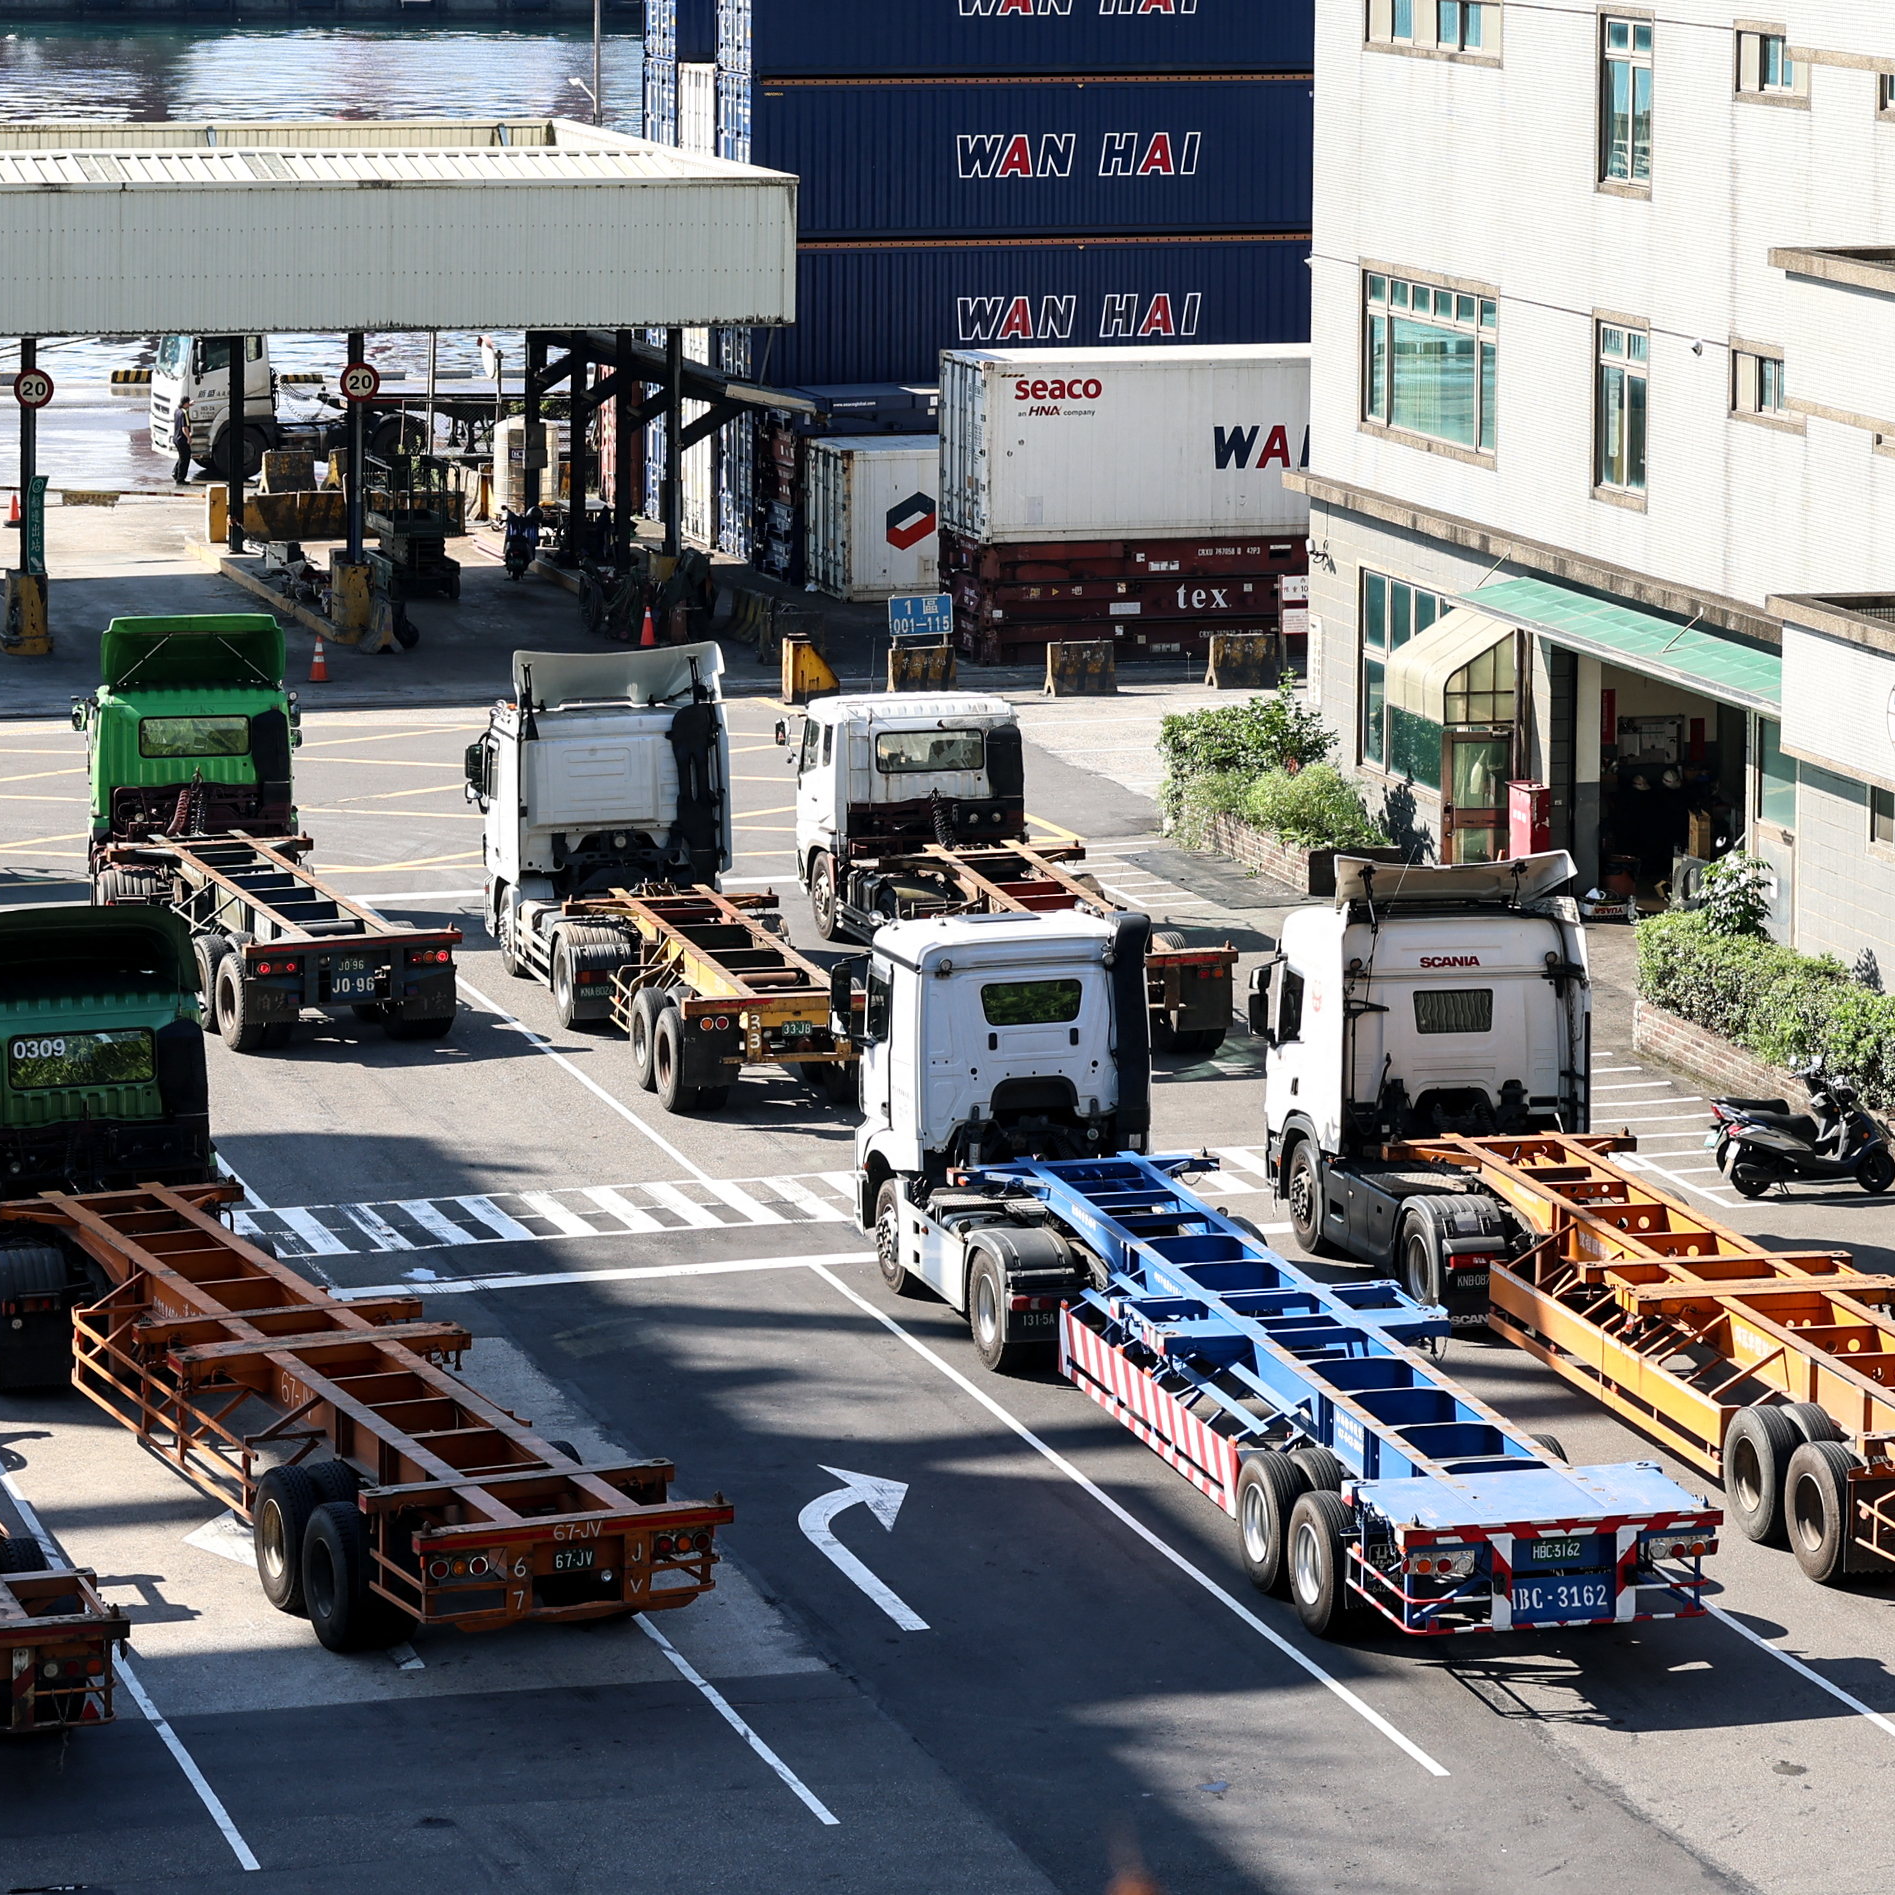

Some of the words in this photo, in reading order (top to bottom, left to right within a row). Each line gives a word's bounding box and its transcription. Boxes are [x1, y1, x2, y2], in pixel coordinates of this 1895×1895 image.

[956, 132, 1077, 179] WAN
[1098, 130, 1202, 177] HAI
[957, 294, 1077, 341] WAN
[1099, 292, 1202, 338] HAI
[22, 380, 46, 397] 20
[348, 374, 372, 391] 20
[1014, 378, 1103, 400] seaco
[1028, 405, 1062, 417] HNA
[1063, 408, 1096, 418] company
[1213, 423, 1309, 470] WA
[1176, 583, 1229, 610] tex
[904, 599, 912, 615] 1
[921, 597, 940, 616] 區
[1419, 955, 1481, 970] SCANIA
[783, 1022, 812, 1035] 33-JB
[13, 1038, 66, 1060] 0309
[1450, 1313, 1489, 1327] SCAN
[553, 1520, 603, 1542] 67-JV
[555, 1551, 593, 1569] 67-JV
[1532, 1542, 1581, 1561] HBC-3162
[1510, 1584, 1609, 1612] HBC-3162
